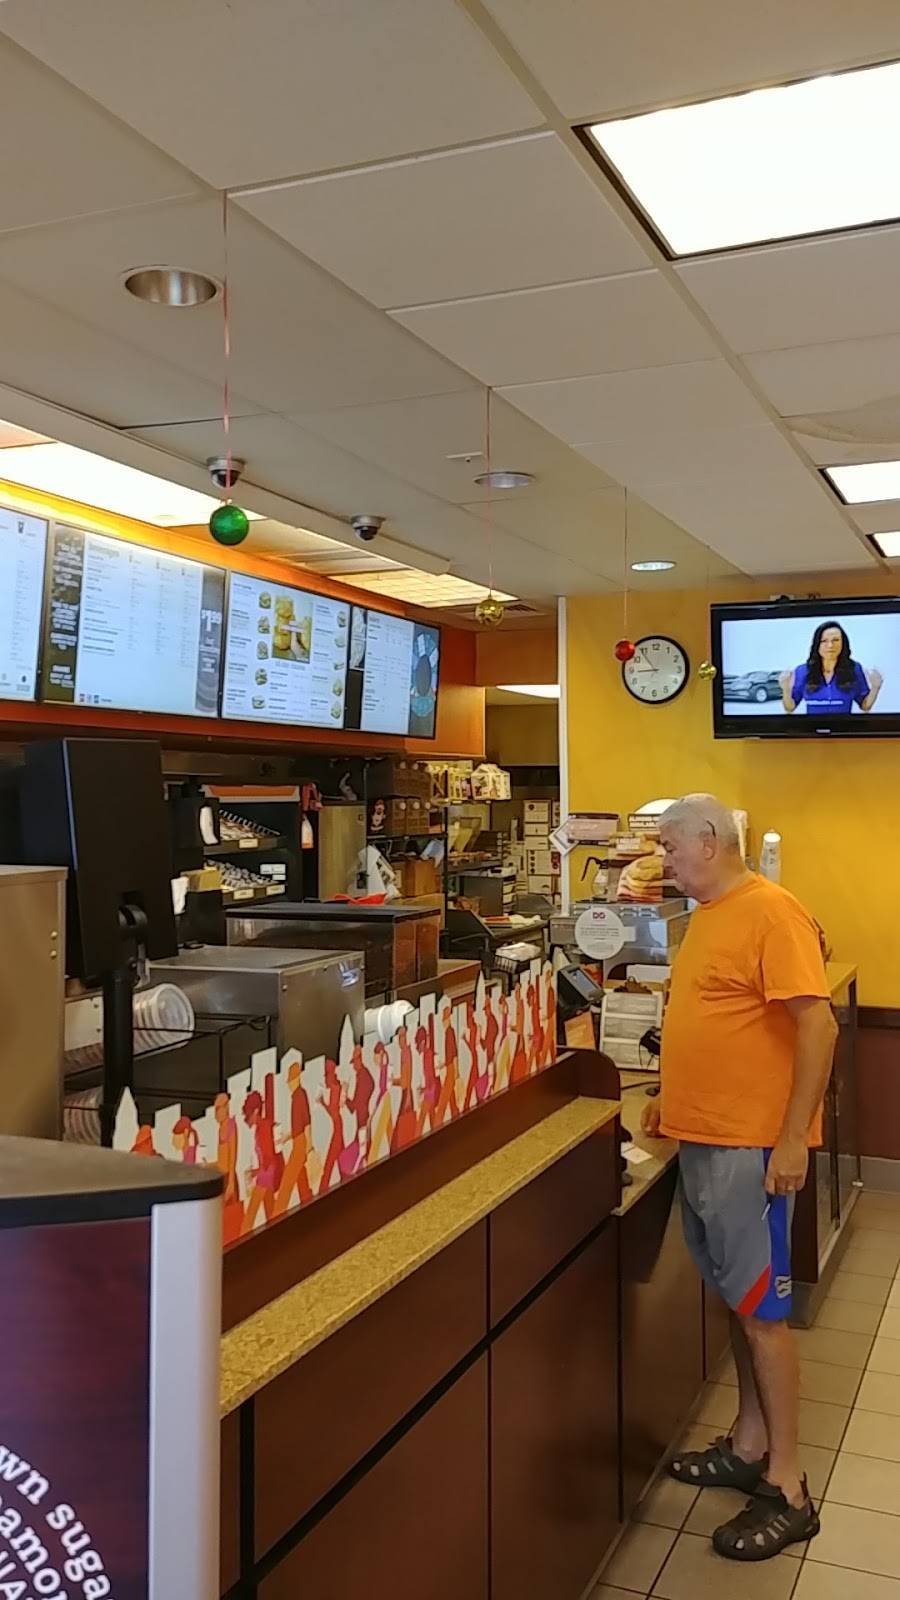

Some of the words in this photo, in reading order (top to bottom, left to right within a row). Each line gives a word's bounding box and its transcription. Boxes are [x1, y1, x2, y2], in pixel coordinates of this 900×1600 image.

[652, 643, 661, 651] 12
[634, 656, 641, 664] 10
[673, 655, 679, 663] 2
[629, 667, 635, 675] 9
[676, 666, 682, 674] 3
[632, 678, 638, 686] 8
[640, 686, 647, 694] 7
[651, 689, 658, 697] 6
[663, 686, 669, 694] 5
[0, 1497, 67, 1600] amo
[45, 1503, 114, 1600] suga
